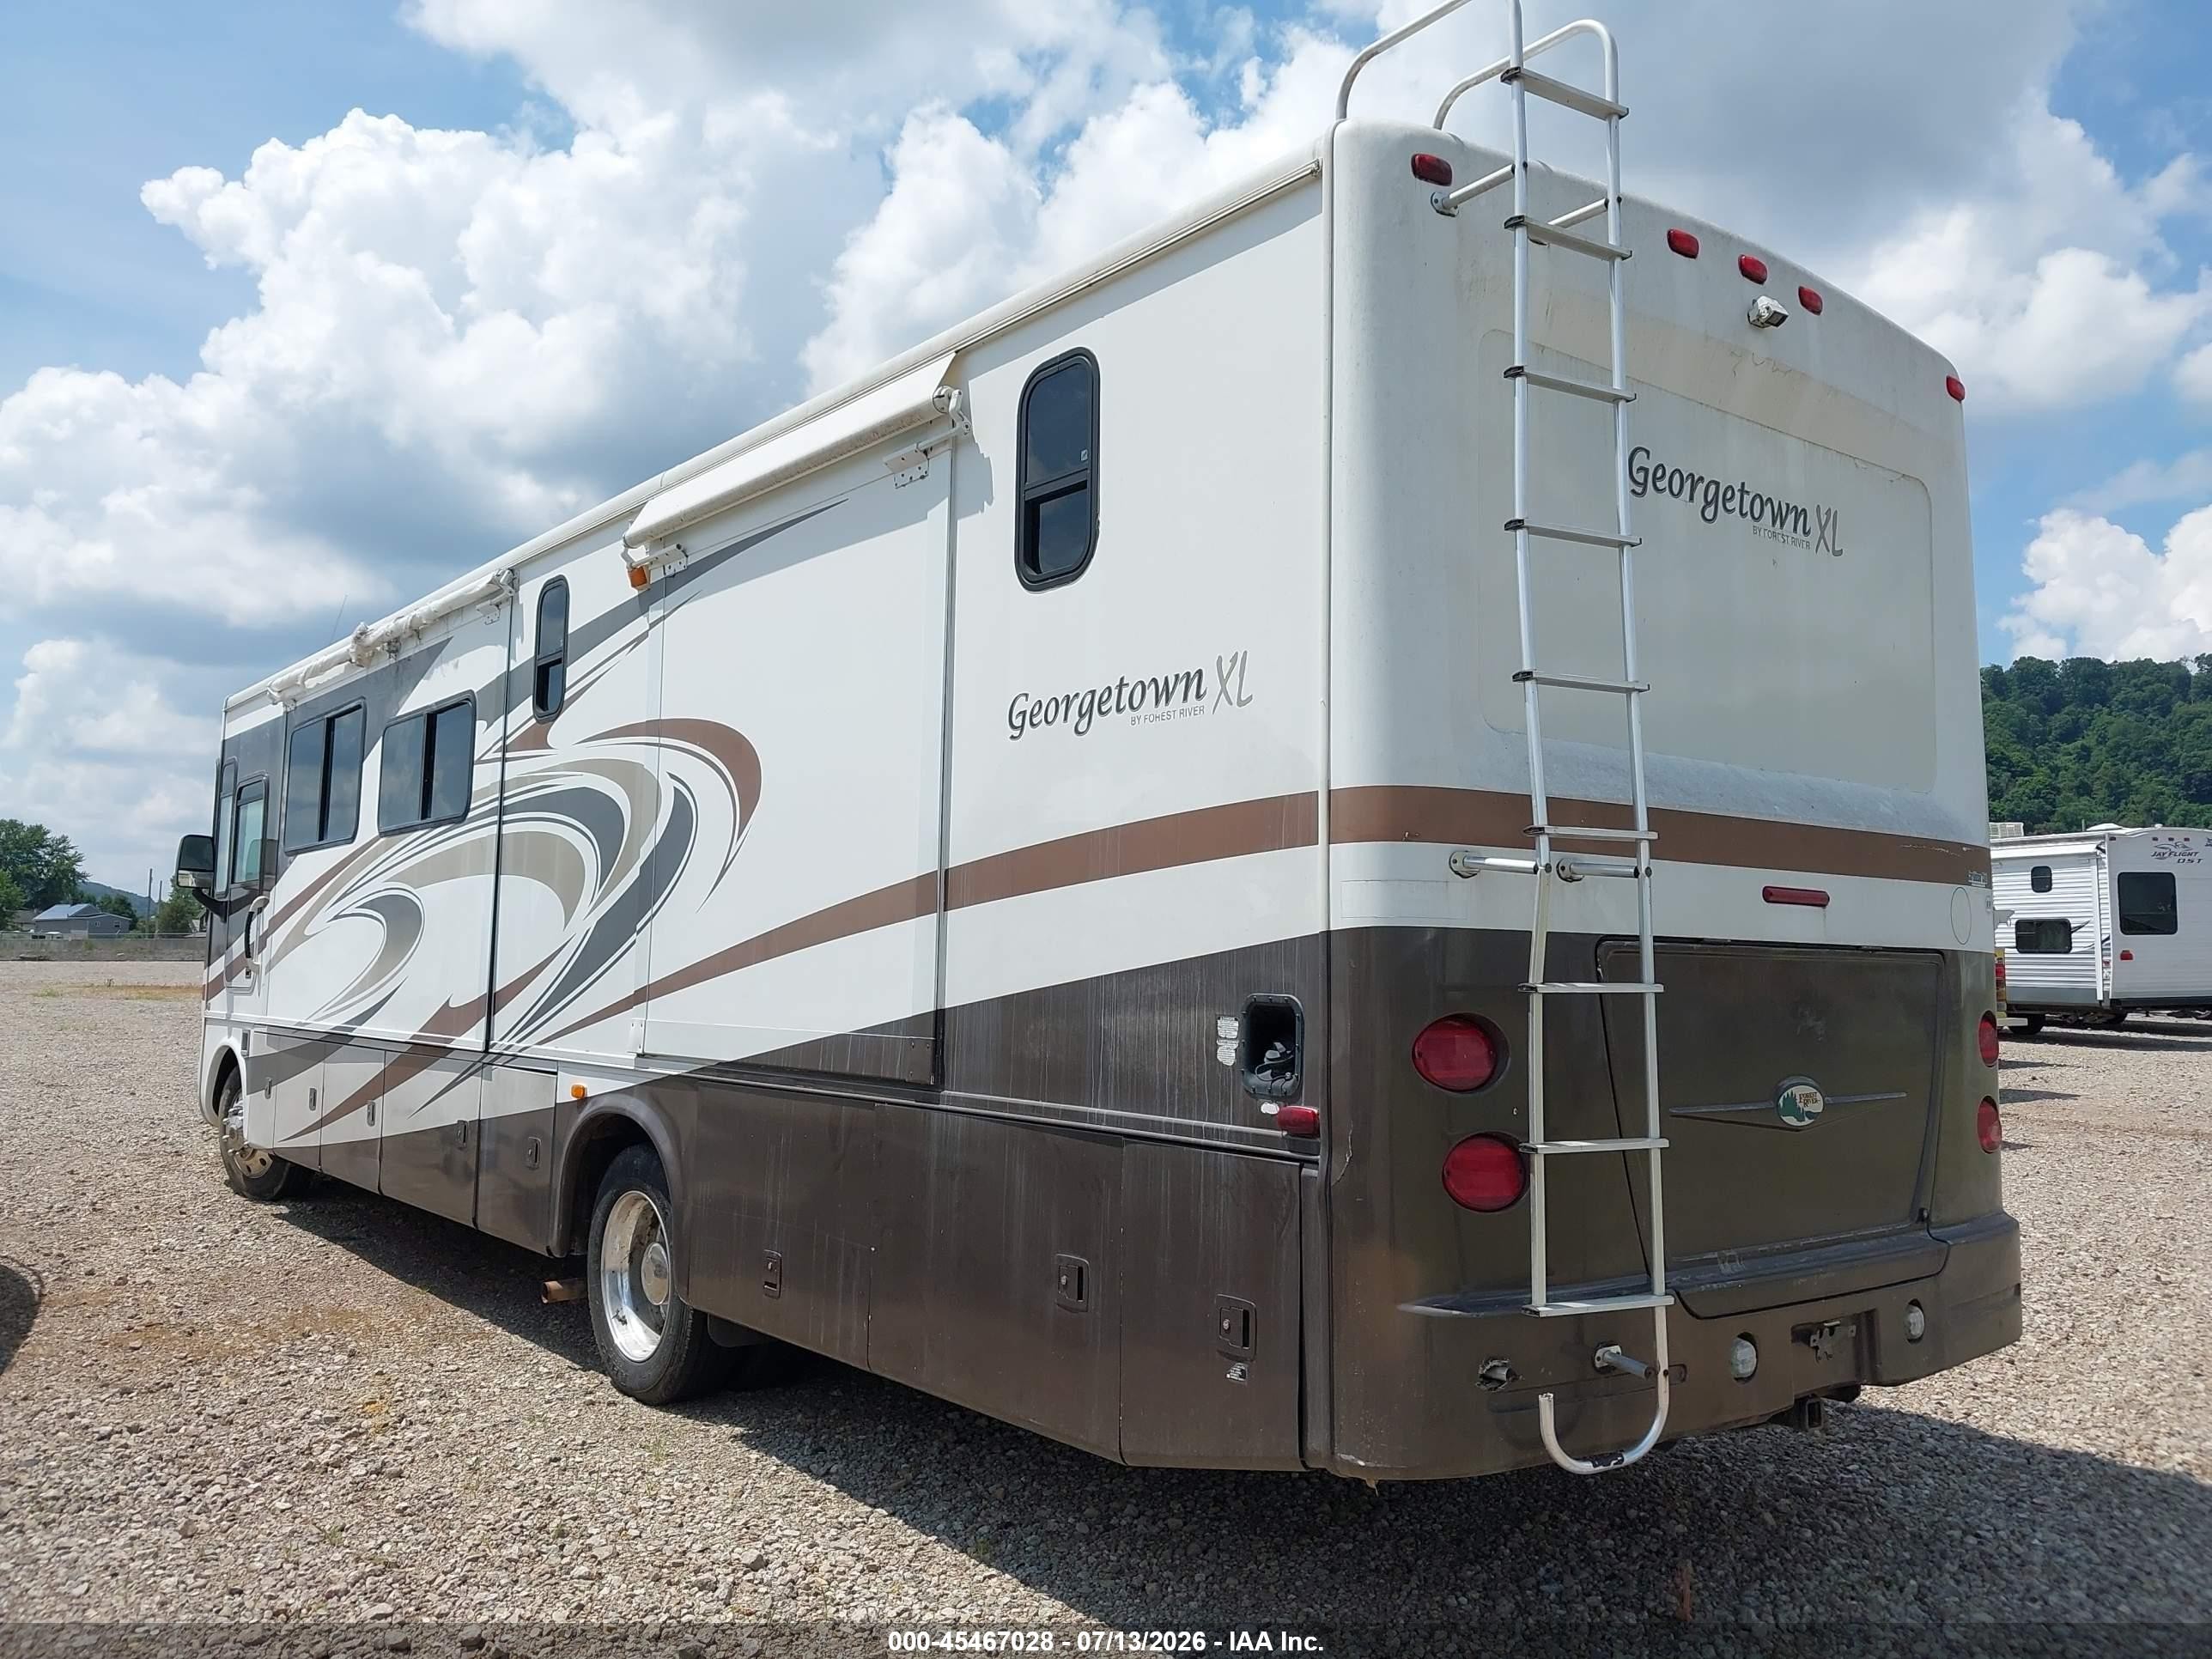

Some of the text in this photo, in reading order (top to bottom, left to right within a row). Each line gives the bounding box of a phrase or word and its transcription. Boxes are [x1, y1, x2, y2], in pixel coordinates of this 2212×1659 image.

[1628, 446, 1844, 556] Georgetown XL
[1753, 526, 1762, 537] BY
[1008, 650, 1254, 741] Georgetown XL
[1130, 714, 1142, 726] BY
[1179, 705, 1205, 719] RIVER
[1799, 1092, 1818, 1103] FOREST
